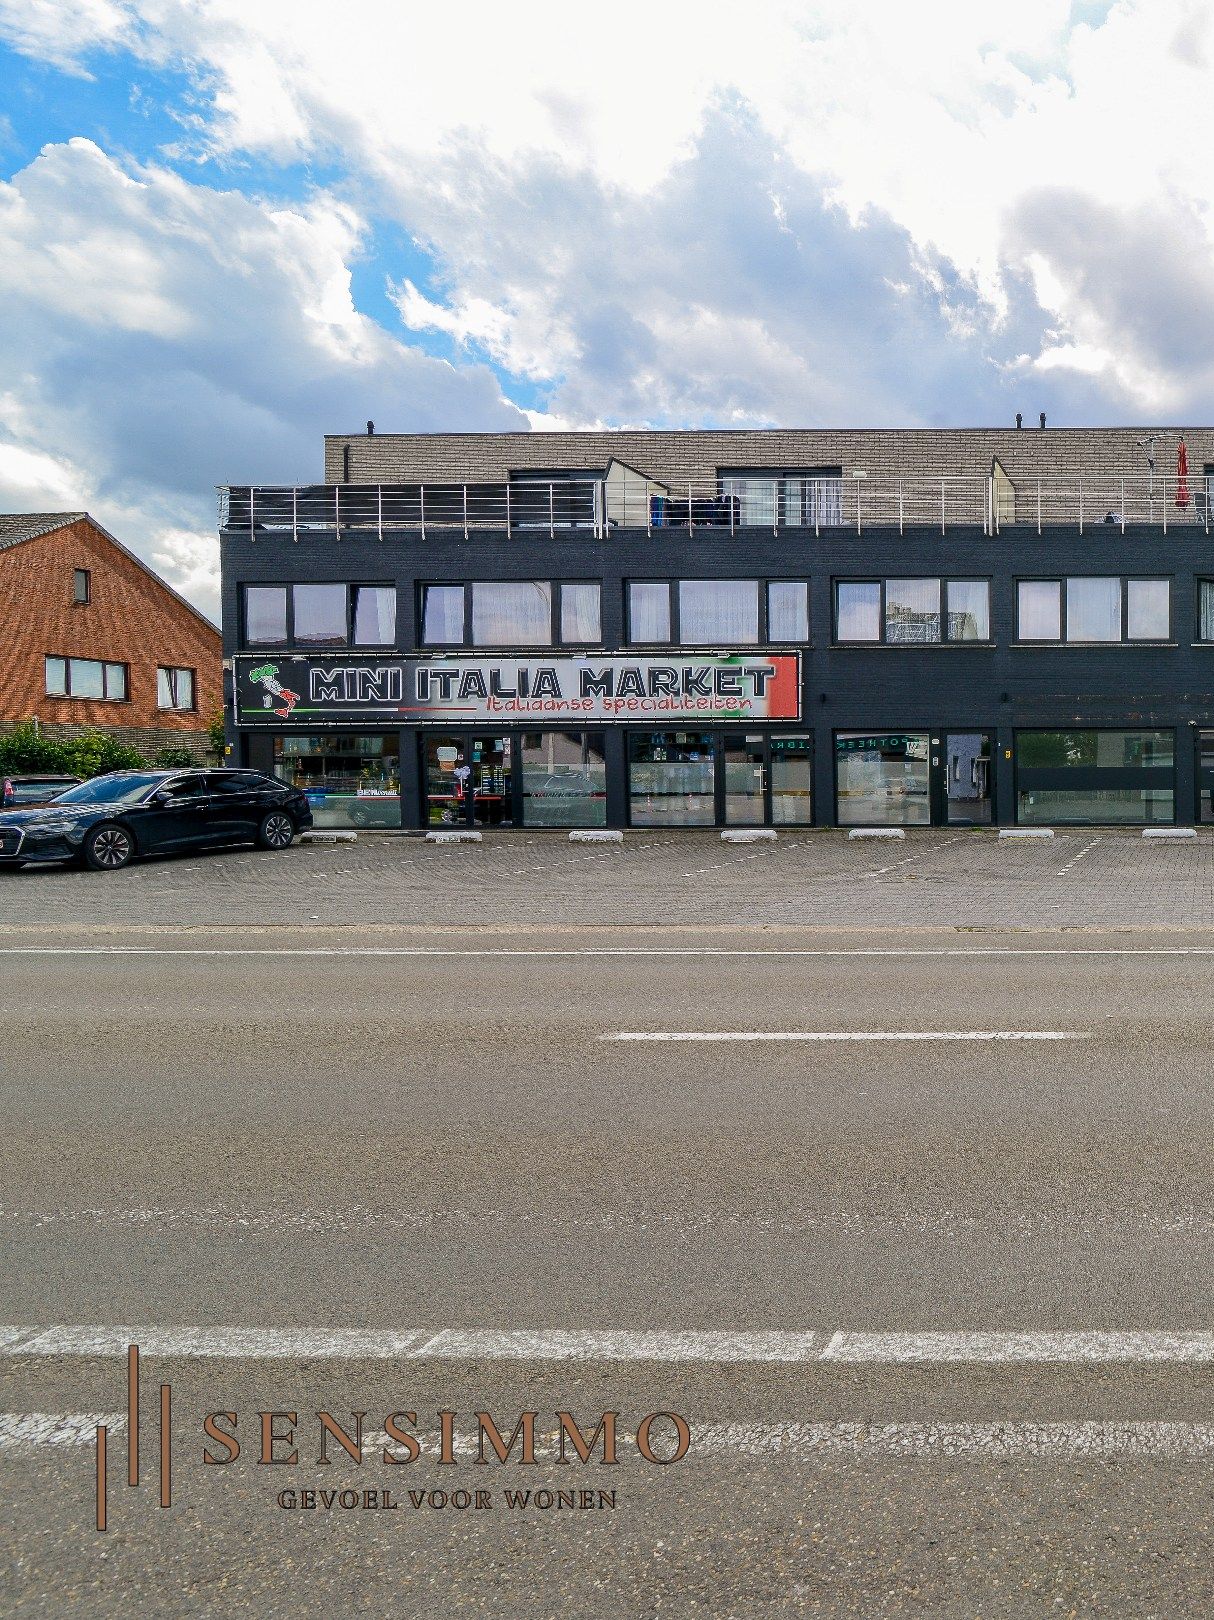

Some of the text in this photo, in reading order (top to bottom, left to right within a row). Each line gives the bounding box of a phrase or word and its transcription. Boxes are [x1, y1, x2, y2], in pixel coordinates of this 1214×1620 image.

[310, 666, 776, 701] MINI ITALIA MARKET
[486, 694, 753, 714] Italiaanse specialiteiten
